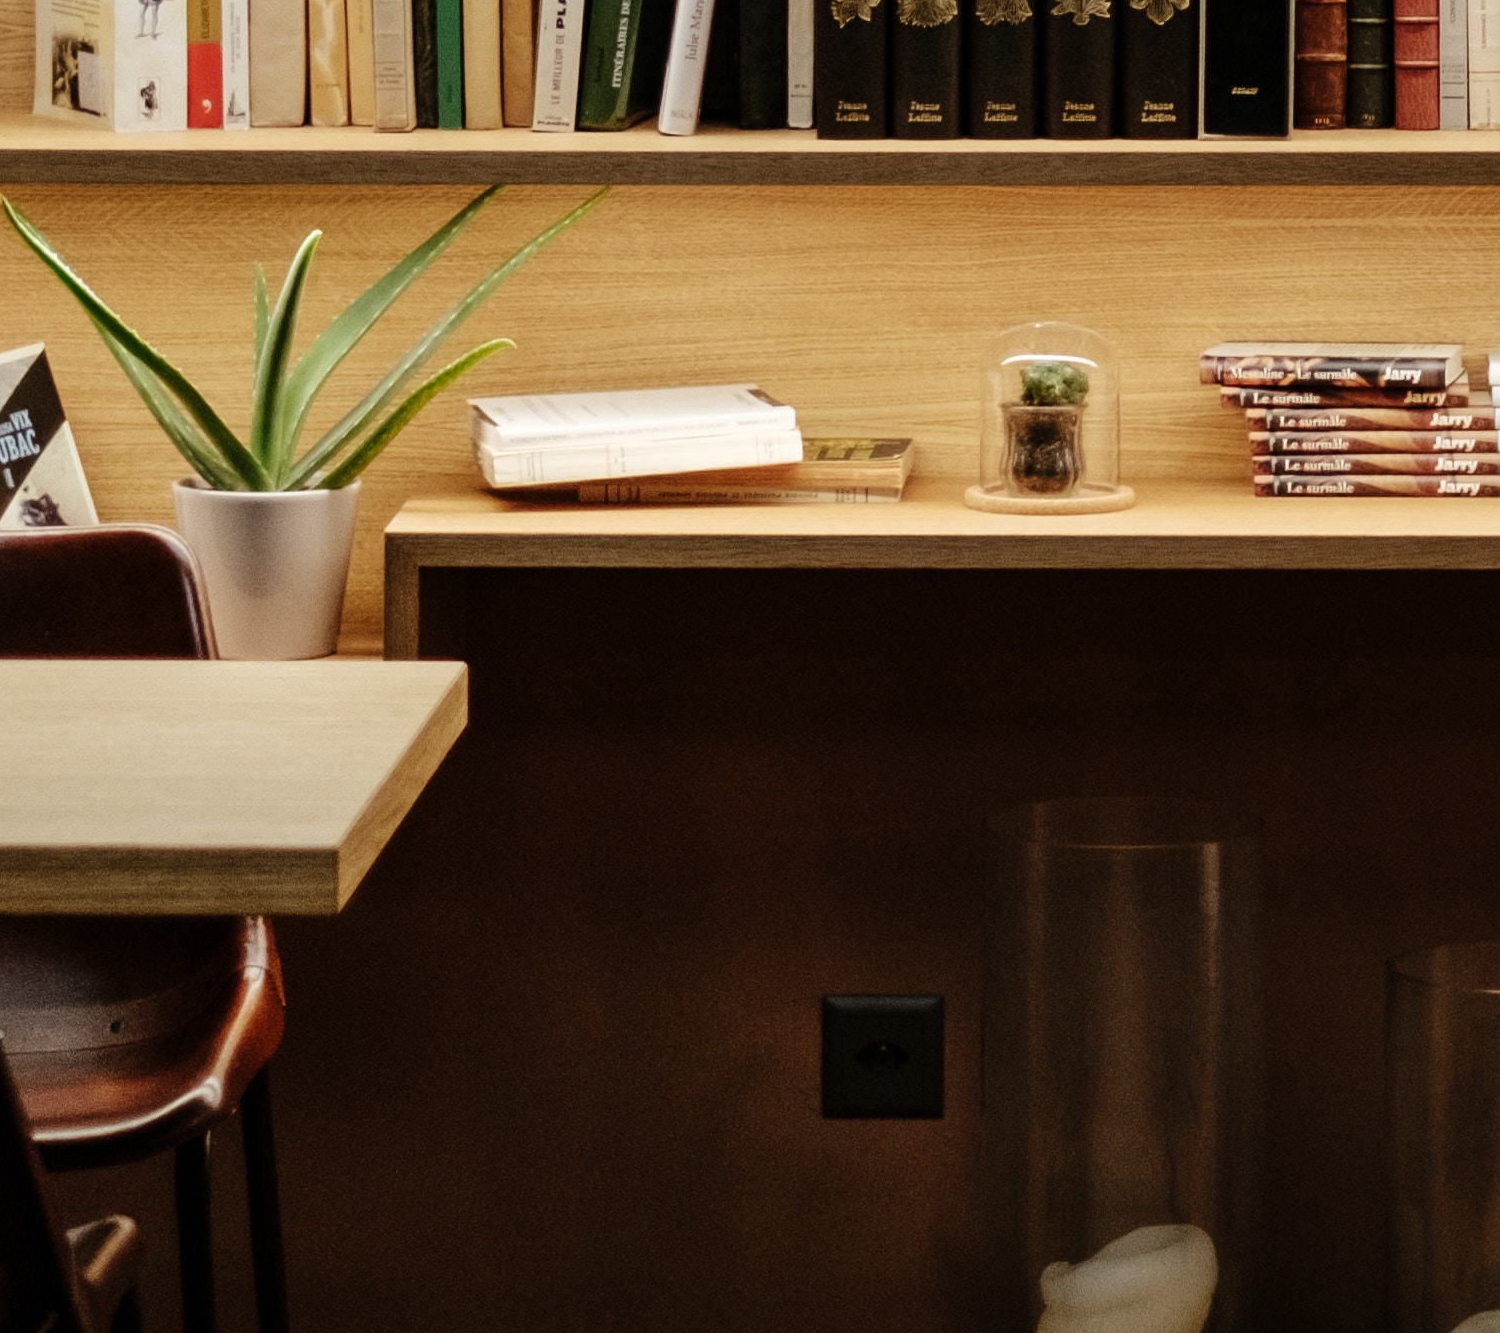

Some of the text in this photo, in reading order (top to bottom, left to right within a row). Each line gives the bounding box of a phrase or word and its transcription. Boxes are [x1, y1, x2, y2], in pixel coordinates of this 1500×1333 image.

[620, 0, 630, 14] DE
[685, 30, 698, 61] Julie
[551, 92, 560, 104] LE
[556, 34, 565, 45] DE
[10, 409, 33, 429] VIX
[1280, 416, 1346, 427] Le surmâle
[1429, 412, 1472, 428] Jarry
